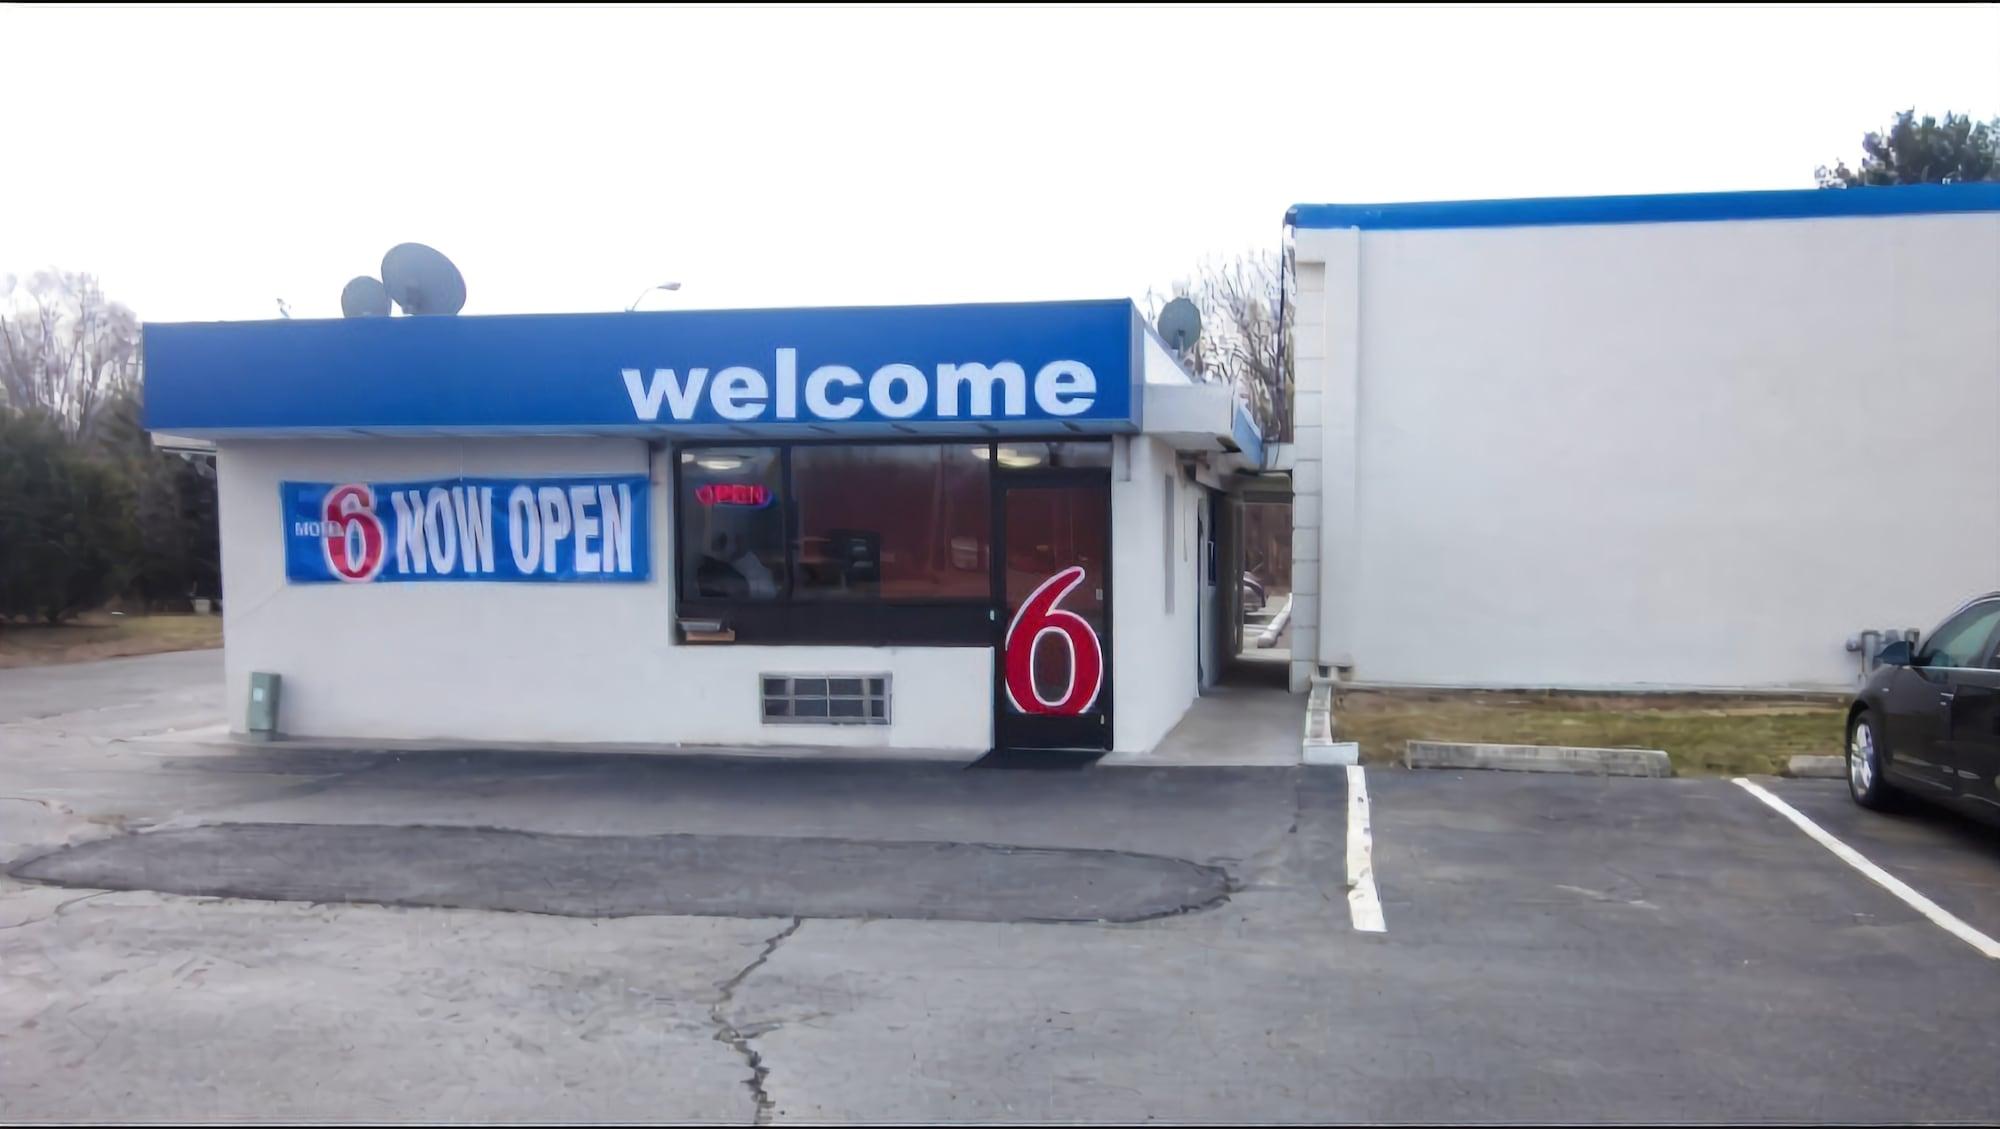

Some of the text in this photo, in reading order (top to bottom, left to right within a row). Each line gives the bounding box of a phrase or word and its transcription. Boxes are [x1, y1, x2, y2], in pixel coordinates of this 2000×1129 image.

[621, 347, 1097, 420] welcome
[322, 484, 386, 582] 6
[391, 484, 633, 574] NOW OPEN
[1004, 566, 1103, 714] 6
